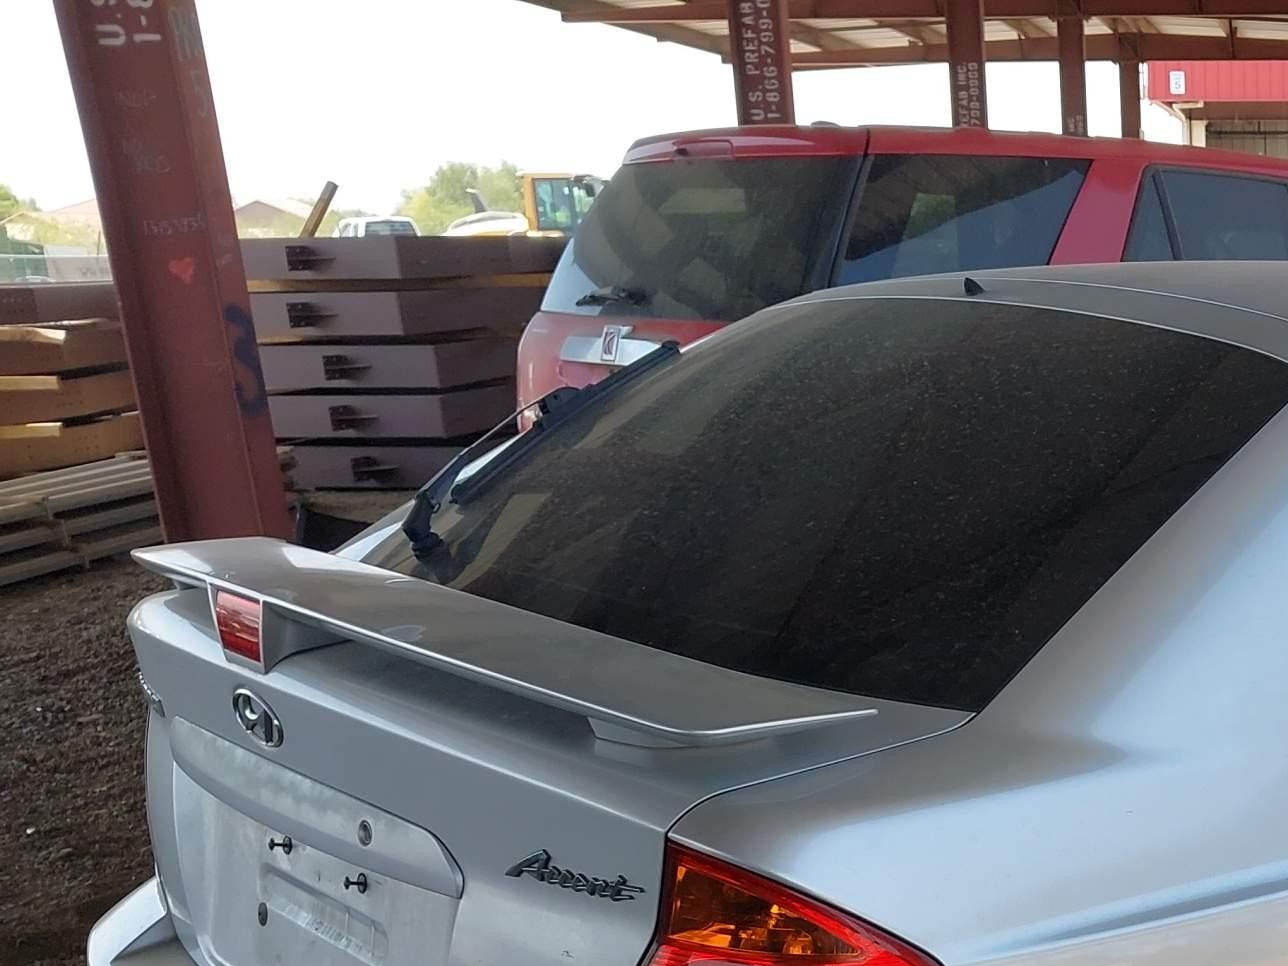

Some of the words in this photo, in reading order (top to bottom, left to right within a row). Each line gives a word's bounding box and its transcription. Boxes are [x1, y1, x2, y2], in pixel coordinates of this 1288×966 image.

[740, 1, 760, 75] PREFAB
[748, 85, 765, 121] U.S.
[504, 848, 646, 902] Accent
